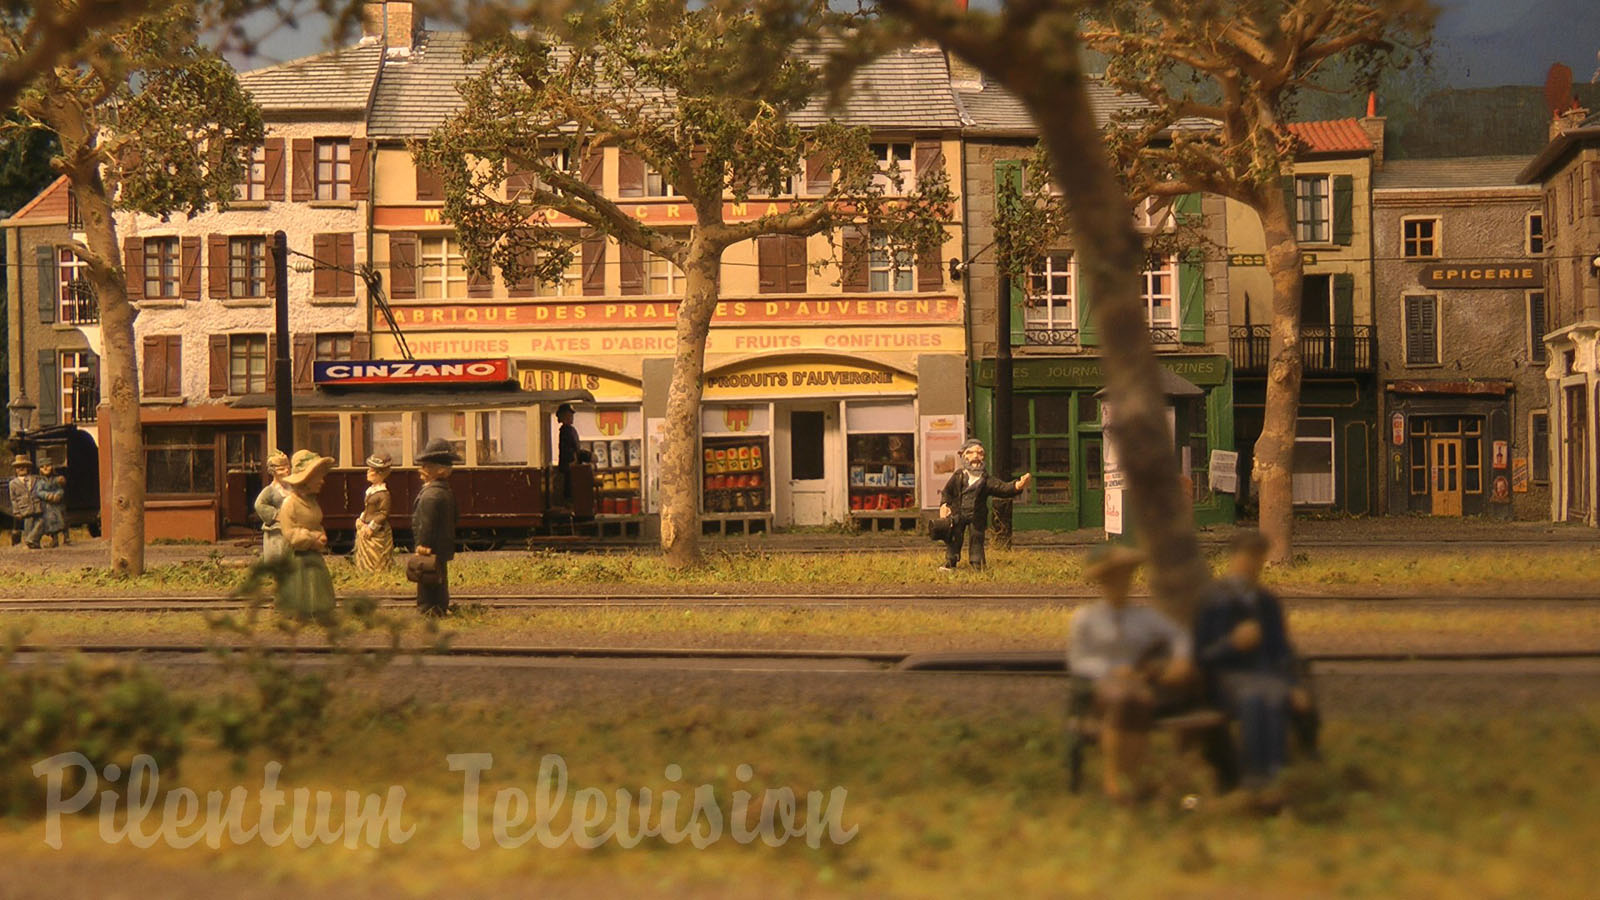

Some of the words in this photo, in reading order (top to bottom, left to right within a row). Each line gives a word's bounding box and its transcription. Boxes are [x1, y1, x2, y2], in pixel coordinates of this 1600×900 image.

[1432, 268, 1534, 280] EPICERIE
[376, 307, 518, 323] FABRIQUE
[536, 305, 587, 320] DES
[605, 302, 747, 318] PRALES
[766, 300, 947, 316] D'AUVERGNE
[393, 339, 509, 355] CONFITURES
[531, 335, 591, 351] PÂTES
[601, 335, 712, 351] D'ABRICS
[735, 334, 802, 349] FRUITS
[823, 333, 942, 347] CONFITURES
[325, 362, 497, 379] CINZANO
[708, 372, 789, 389] PRODUITS
[792, 370, 893, 386] D'AUVERGNE
[982, 367, 1029, 379] LIES
